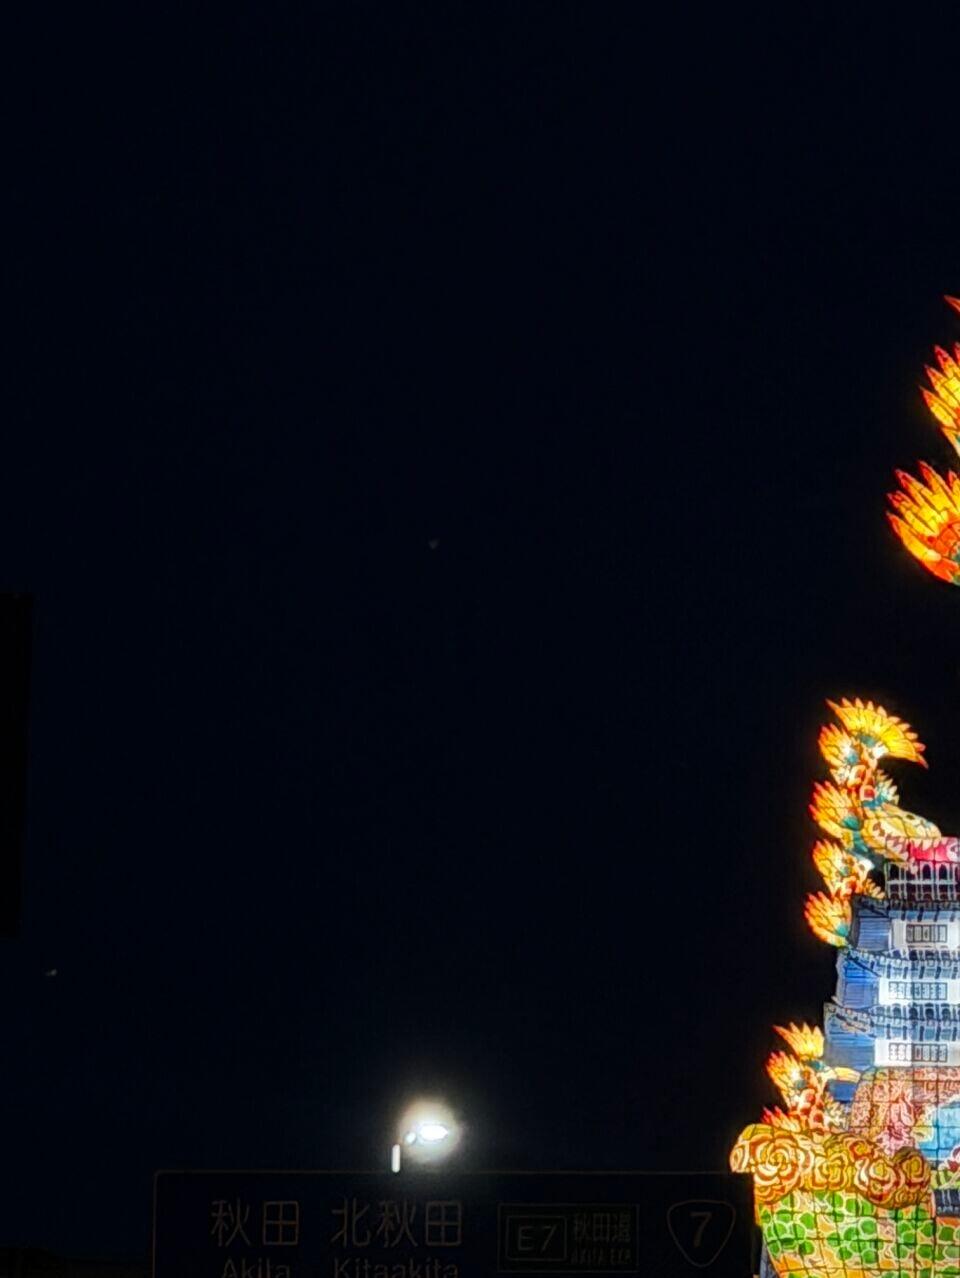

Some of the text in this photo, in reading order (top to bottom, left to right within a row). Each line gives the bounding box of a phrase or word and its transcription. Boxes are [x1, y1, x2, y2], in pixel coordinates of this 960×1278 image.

[209, 1198, 463, 1248] 秋田 北秋田
[517, 1225, 560, 1252] E7
[689, 1211, 712, 1248] 7
